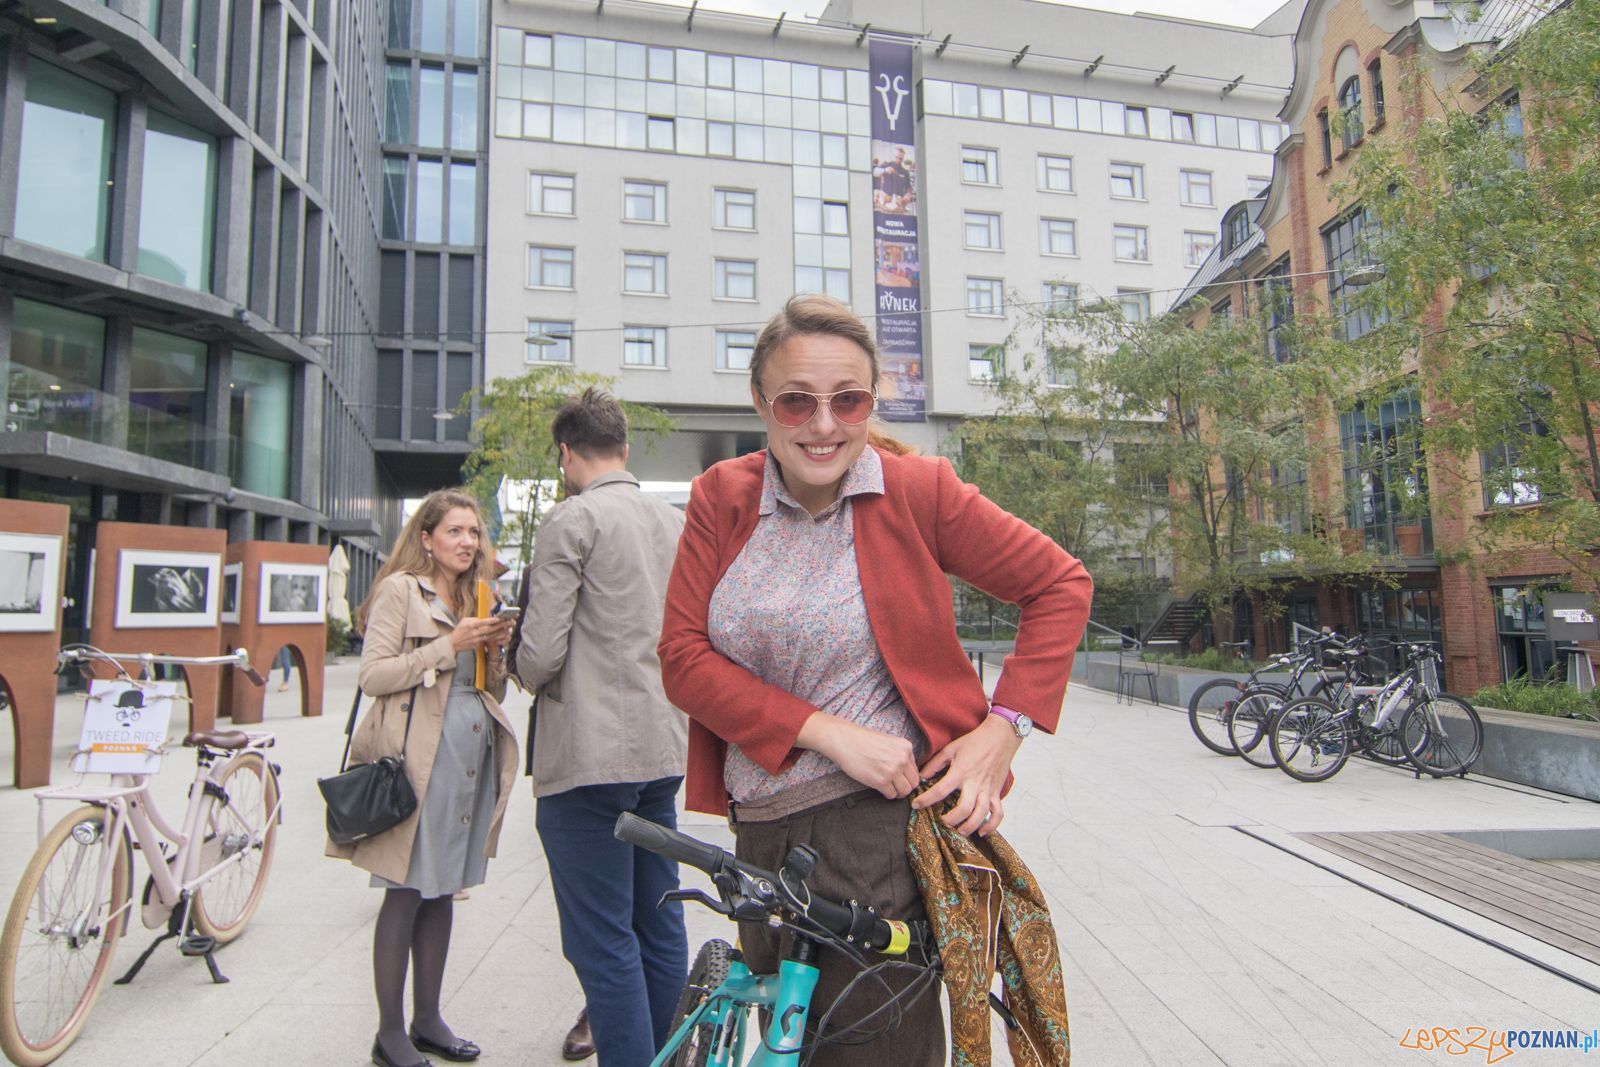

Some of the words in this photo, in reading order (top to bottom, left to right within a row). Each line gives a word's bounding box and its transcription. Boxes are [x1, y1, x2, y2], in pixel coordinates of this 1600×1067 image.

[885, 219, 905, 228] NOWA
[880, 290, 917, 312] RYNEK
[86, 729, 130, 742] TWEED
[133, 730, 163, 743] RIDE
